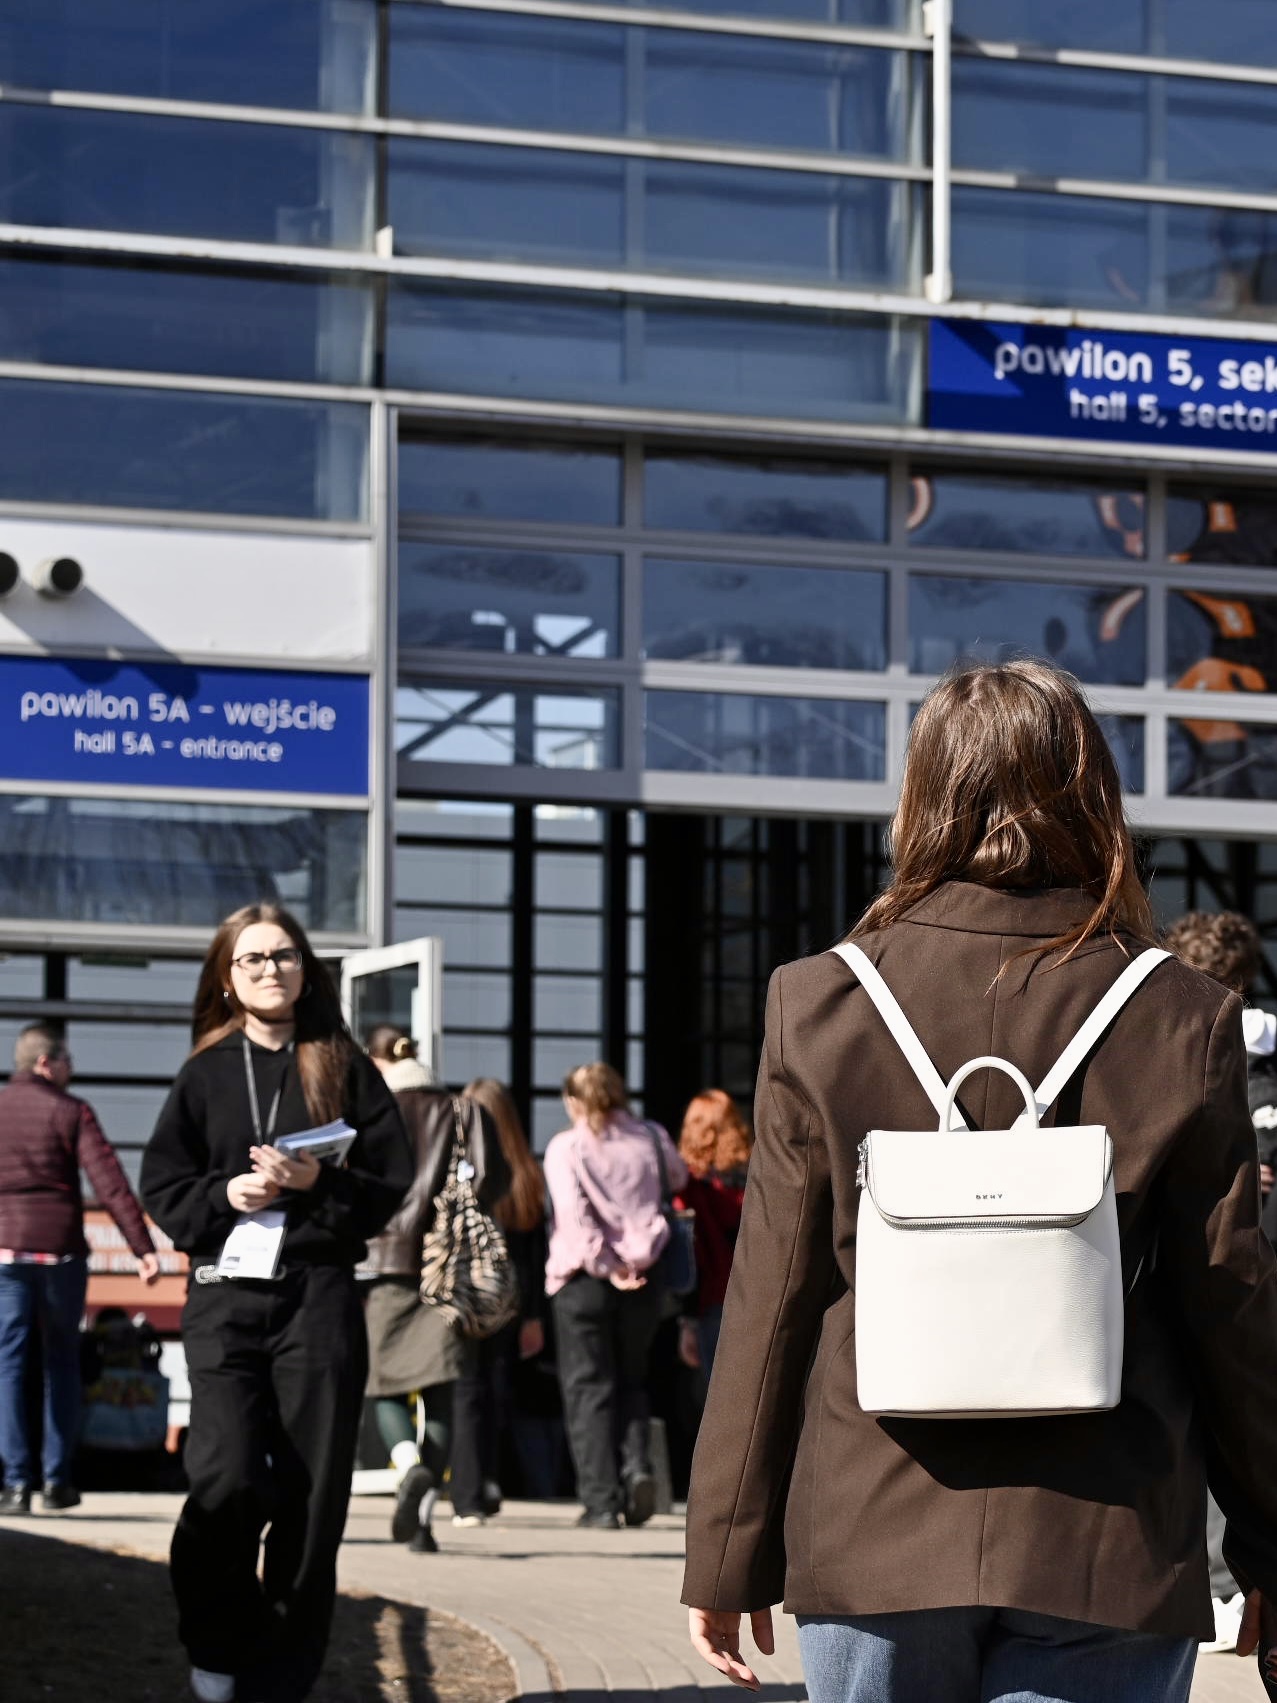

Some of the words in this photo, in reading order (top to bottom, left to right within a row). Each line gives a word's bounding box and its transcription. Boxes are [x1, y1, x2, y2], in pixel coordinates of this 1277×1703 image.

[994, 339, 1153, 384] pawilon
[1167, 349, 1204, 392] 5,
[1069, 388, 1128, 420] hall
[1137, 393, 1167, 428] 5,
[20, 689, 139, 722] pawilon
[148, 692, 191, 723] 5A
[223, 698, 337, 734] wejście
[74, 729, 116, 755] hall
[121, 731, 155, 755] 5A
[179, 736, 284, 763] entrance
